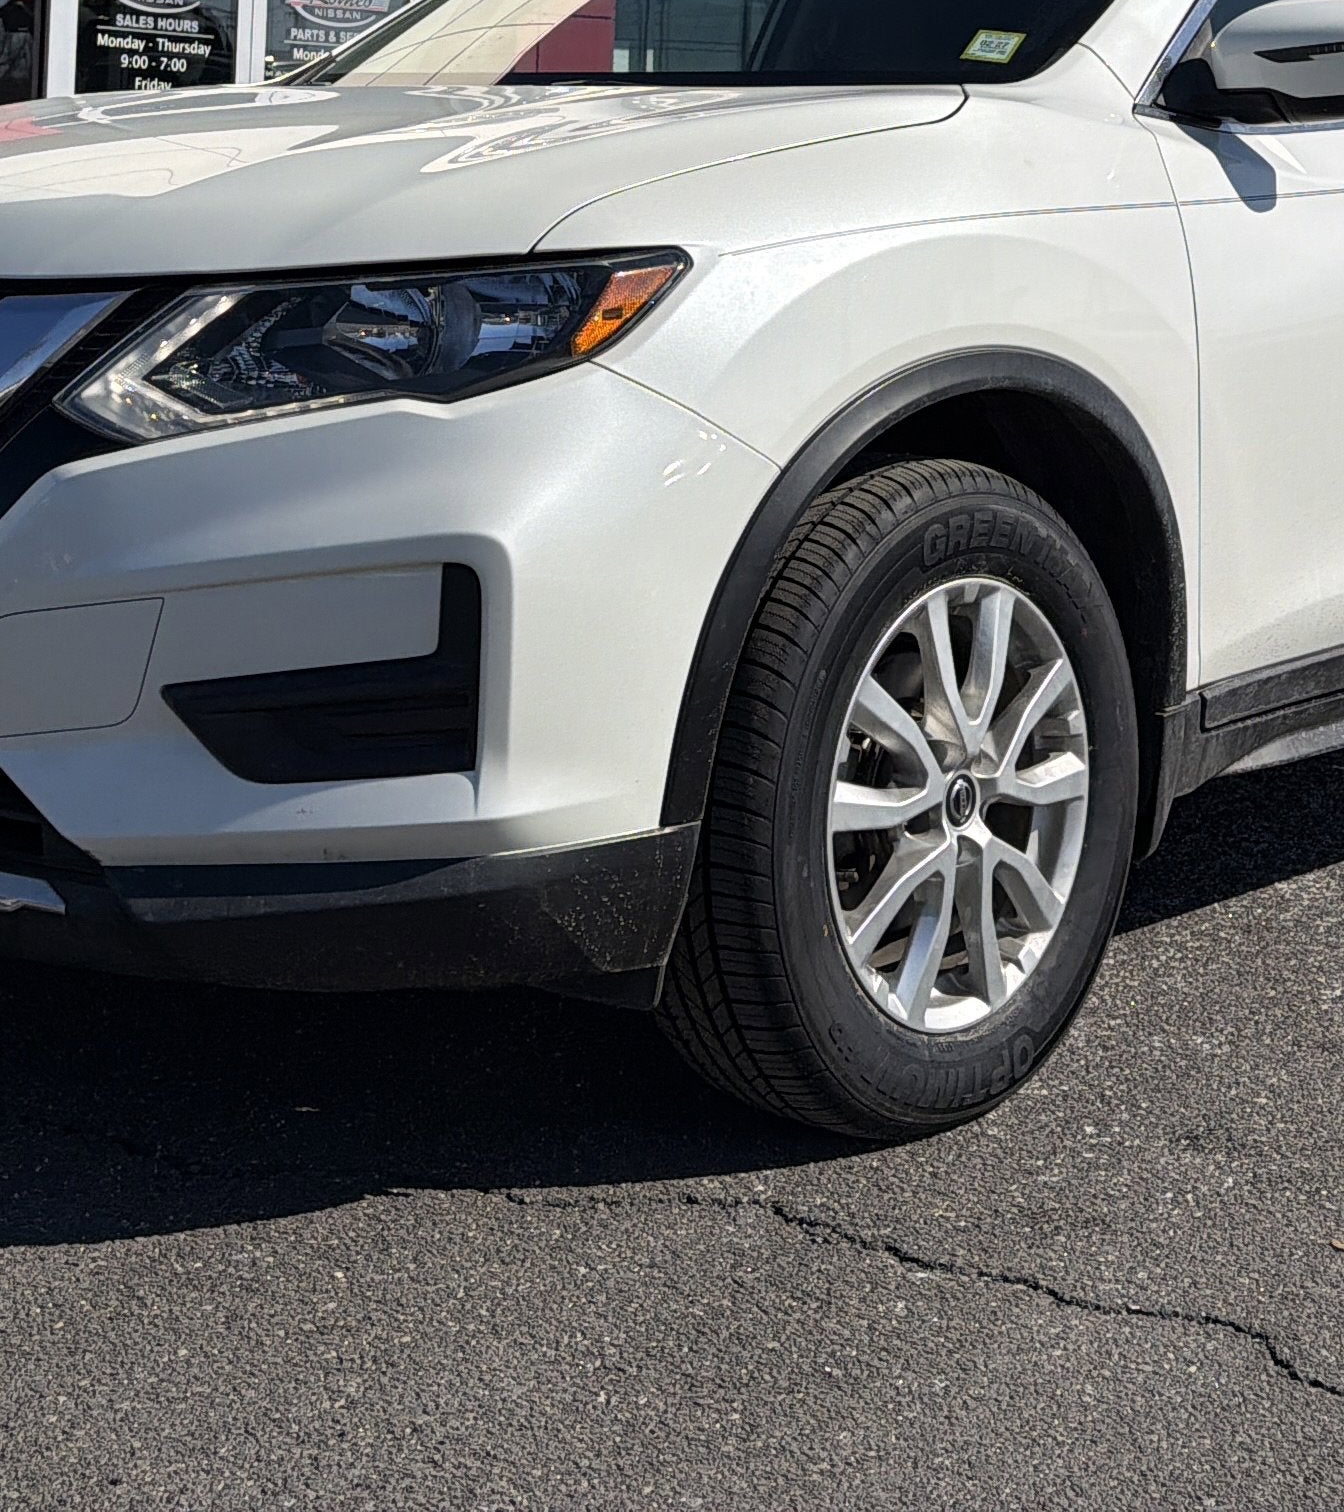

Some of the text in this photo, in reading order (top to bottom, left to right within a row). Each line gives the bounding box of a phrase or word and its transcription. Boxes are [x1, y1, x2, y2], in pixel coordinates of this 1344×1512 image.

[314, 8, 361, 20] NISSAN
[115, 14, 199, 32] SALES HOURS
[290, 28, 326, 41] PARTS
[328, 31, 337, 42] &
[96, 33, 146, 52] Monday
[156, 38, 212, 58] Thursday
[120, 54, 149, 69] 9:00
[160, 57, 187, 72] 7:00
[135, 77, 172, 90] Friday
